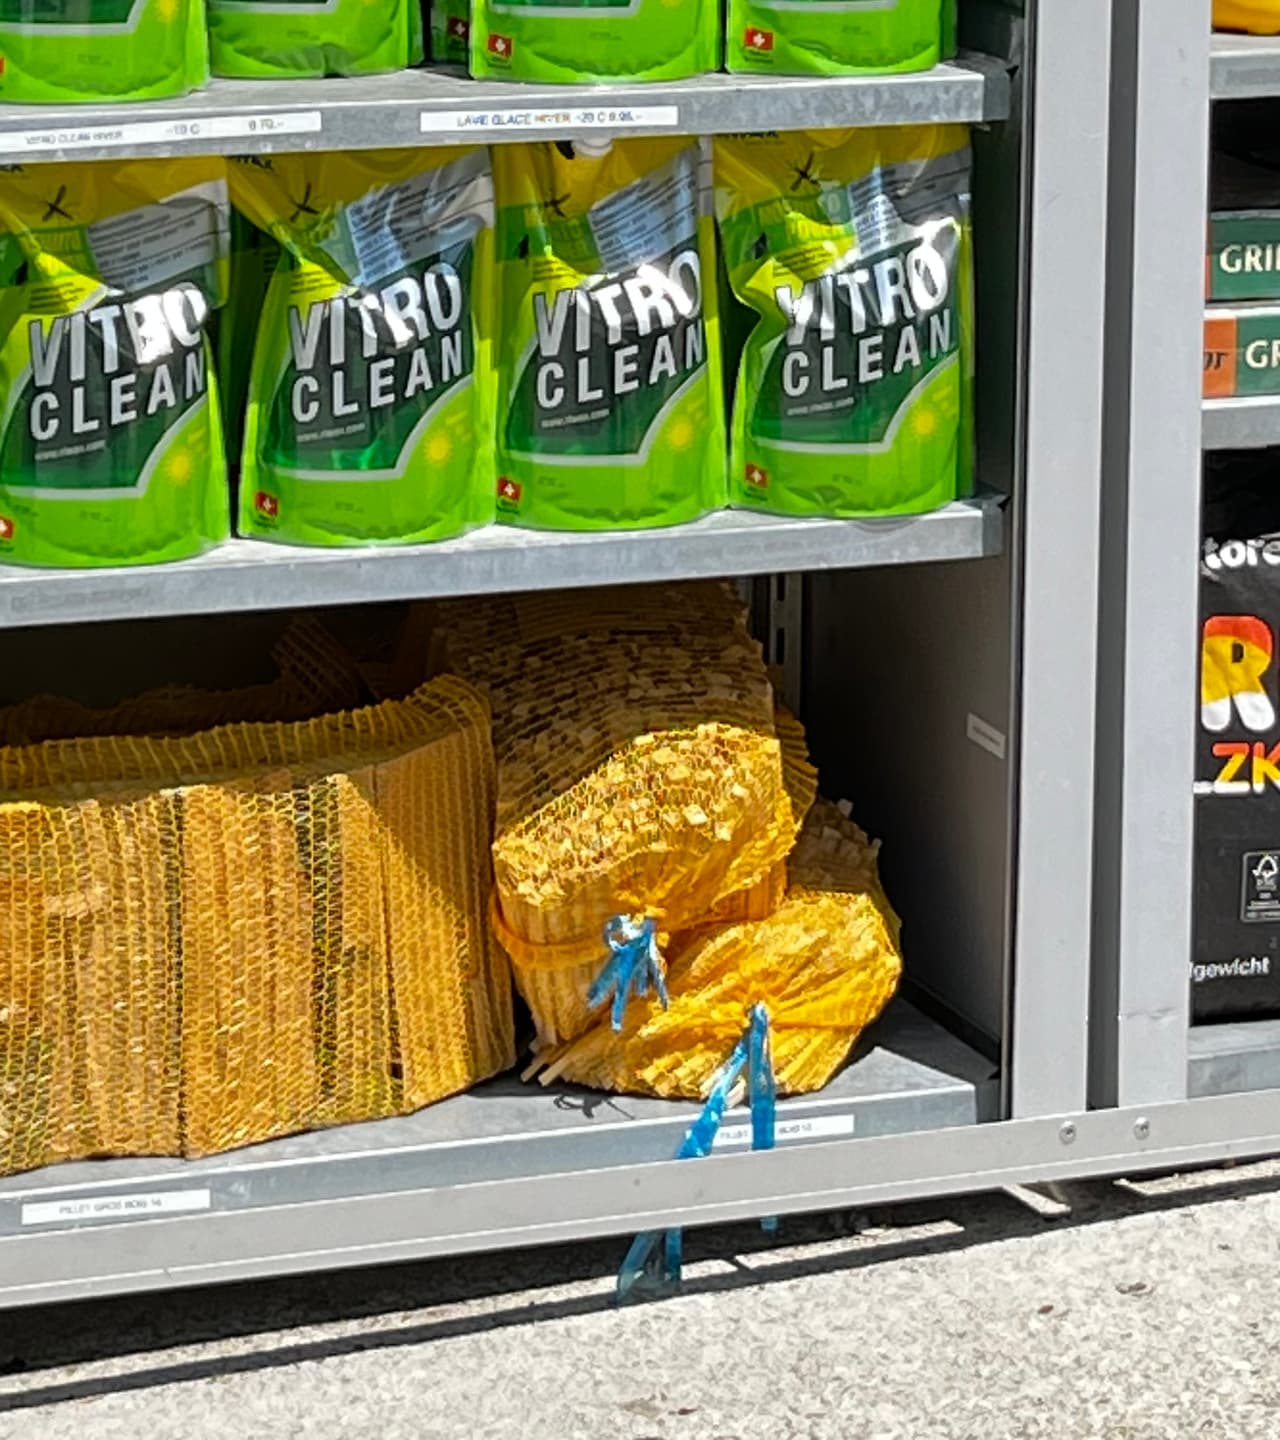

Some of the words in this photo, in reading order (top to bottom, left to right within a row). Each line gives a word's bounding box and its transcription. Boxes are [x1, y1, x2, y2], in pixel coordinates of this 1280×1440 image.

[28, 284, 208, 388] VITRO
[288, 264, 462, 371] VITRO
[532, 250, 702, 358] VITRO
[774, 245, 949, 347] VITRO
[30, 347, 206, 441] CLEAN
[291, 330, 464, 423] CLEAN
[536, 319, 704, 410] CLEAN
[782, 308, 952, 398] CLEAN
